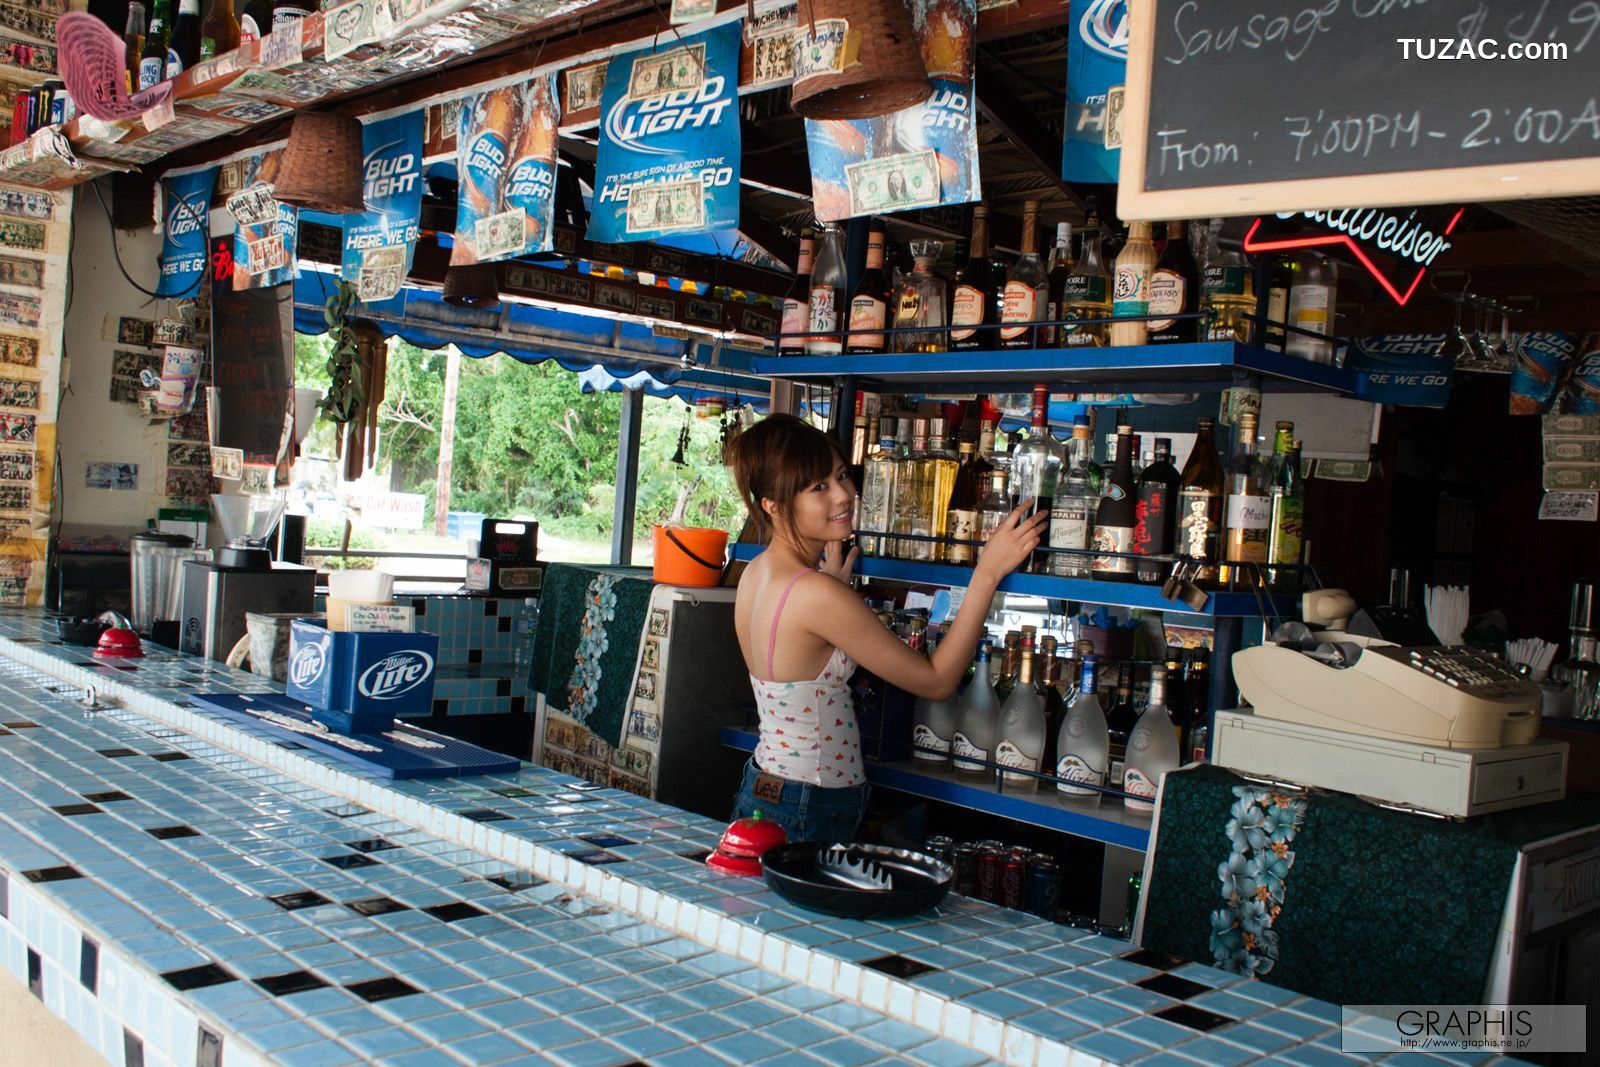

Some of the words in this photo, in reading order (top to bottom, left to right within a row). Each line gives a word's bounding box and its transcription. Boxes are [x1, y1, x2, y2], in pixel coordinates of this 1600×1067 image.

[1165, 0, 1340, 65] Sausage
[927, 90, 968, 111] UD
[621, 99, 732, 142] LIGHT
[921, 109, 969, 131] GHT
[475, 138, 505, 164] BUD
[1157, 124, 1259, 177] From:
[365, 154, 414, 181] BUD
[467, 151, 503, 178] LIGHT
[511, 166, 552, 184] BUD
[619, 171, 632, 182] THE
[706, 157, 725, 166] TIME
[367, 172, 419, 199] IGHT
[504, 181, 552, 200] LIGHT
[346, 232, 384, 251] HERE
[385, 230, 404, 245] WE
[405, 226, 418, 242] GO
[162, 262, 179, 276] HERE
[179, 260, 192, 273] WE
[1394, 375, 1420, 386] WE
[1421, 375, 1448, 386] GO
[367, 495, 385, 511] Car
[389, 497, 421, 513] Wash
[296, 656, 321, 684] Lite
[381, 656, 416, 670] Miller
[371, 663, 423, 697] Lite
[754, 777, 780, 800] Lee
